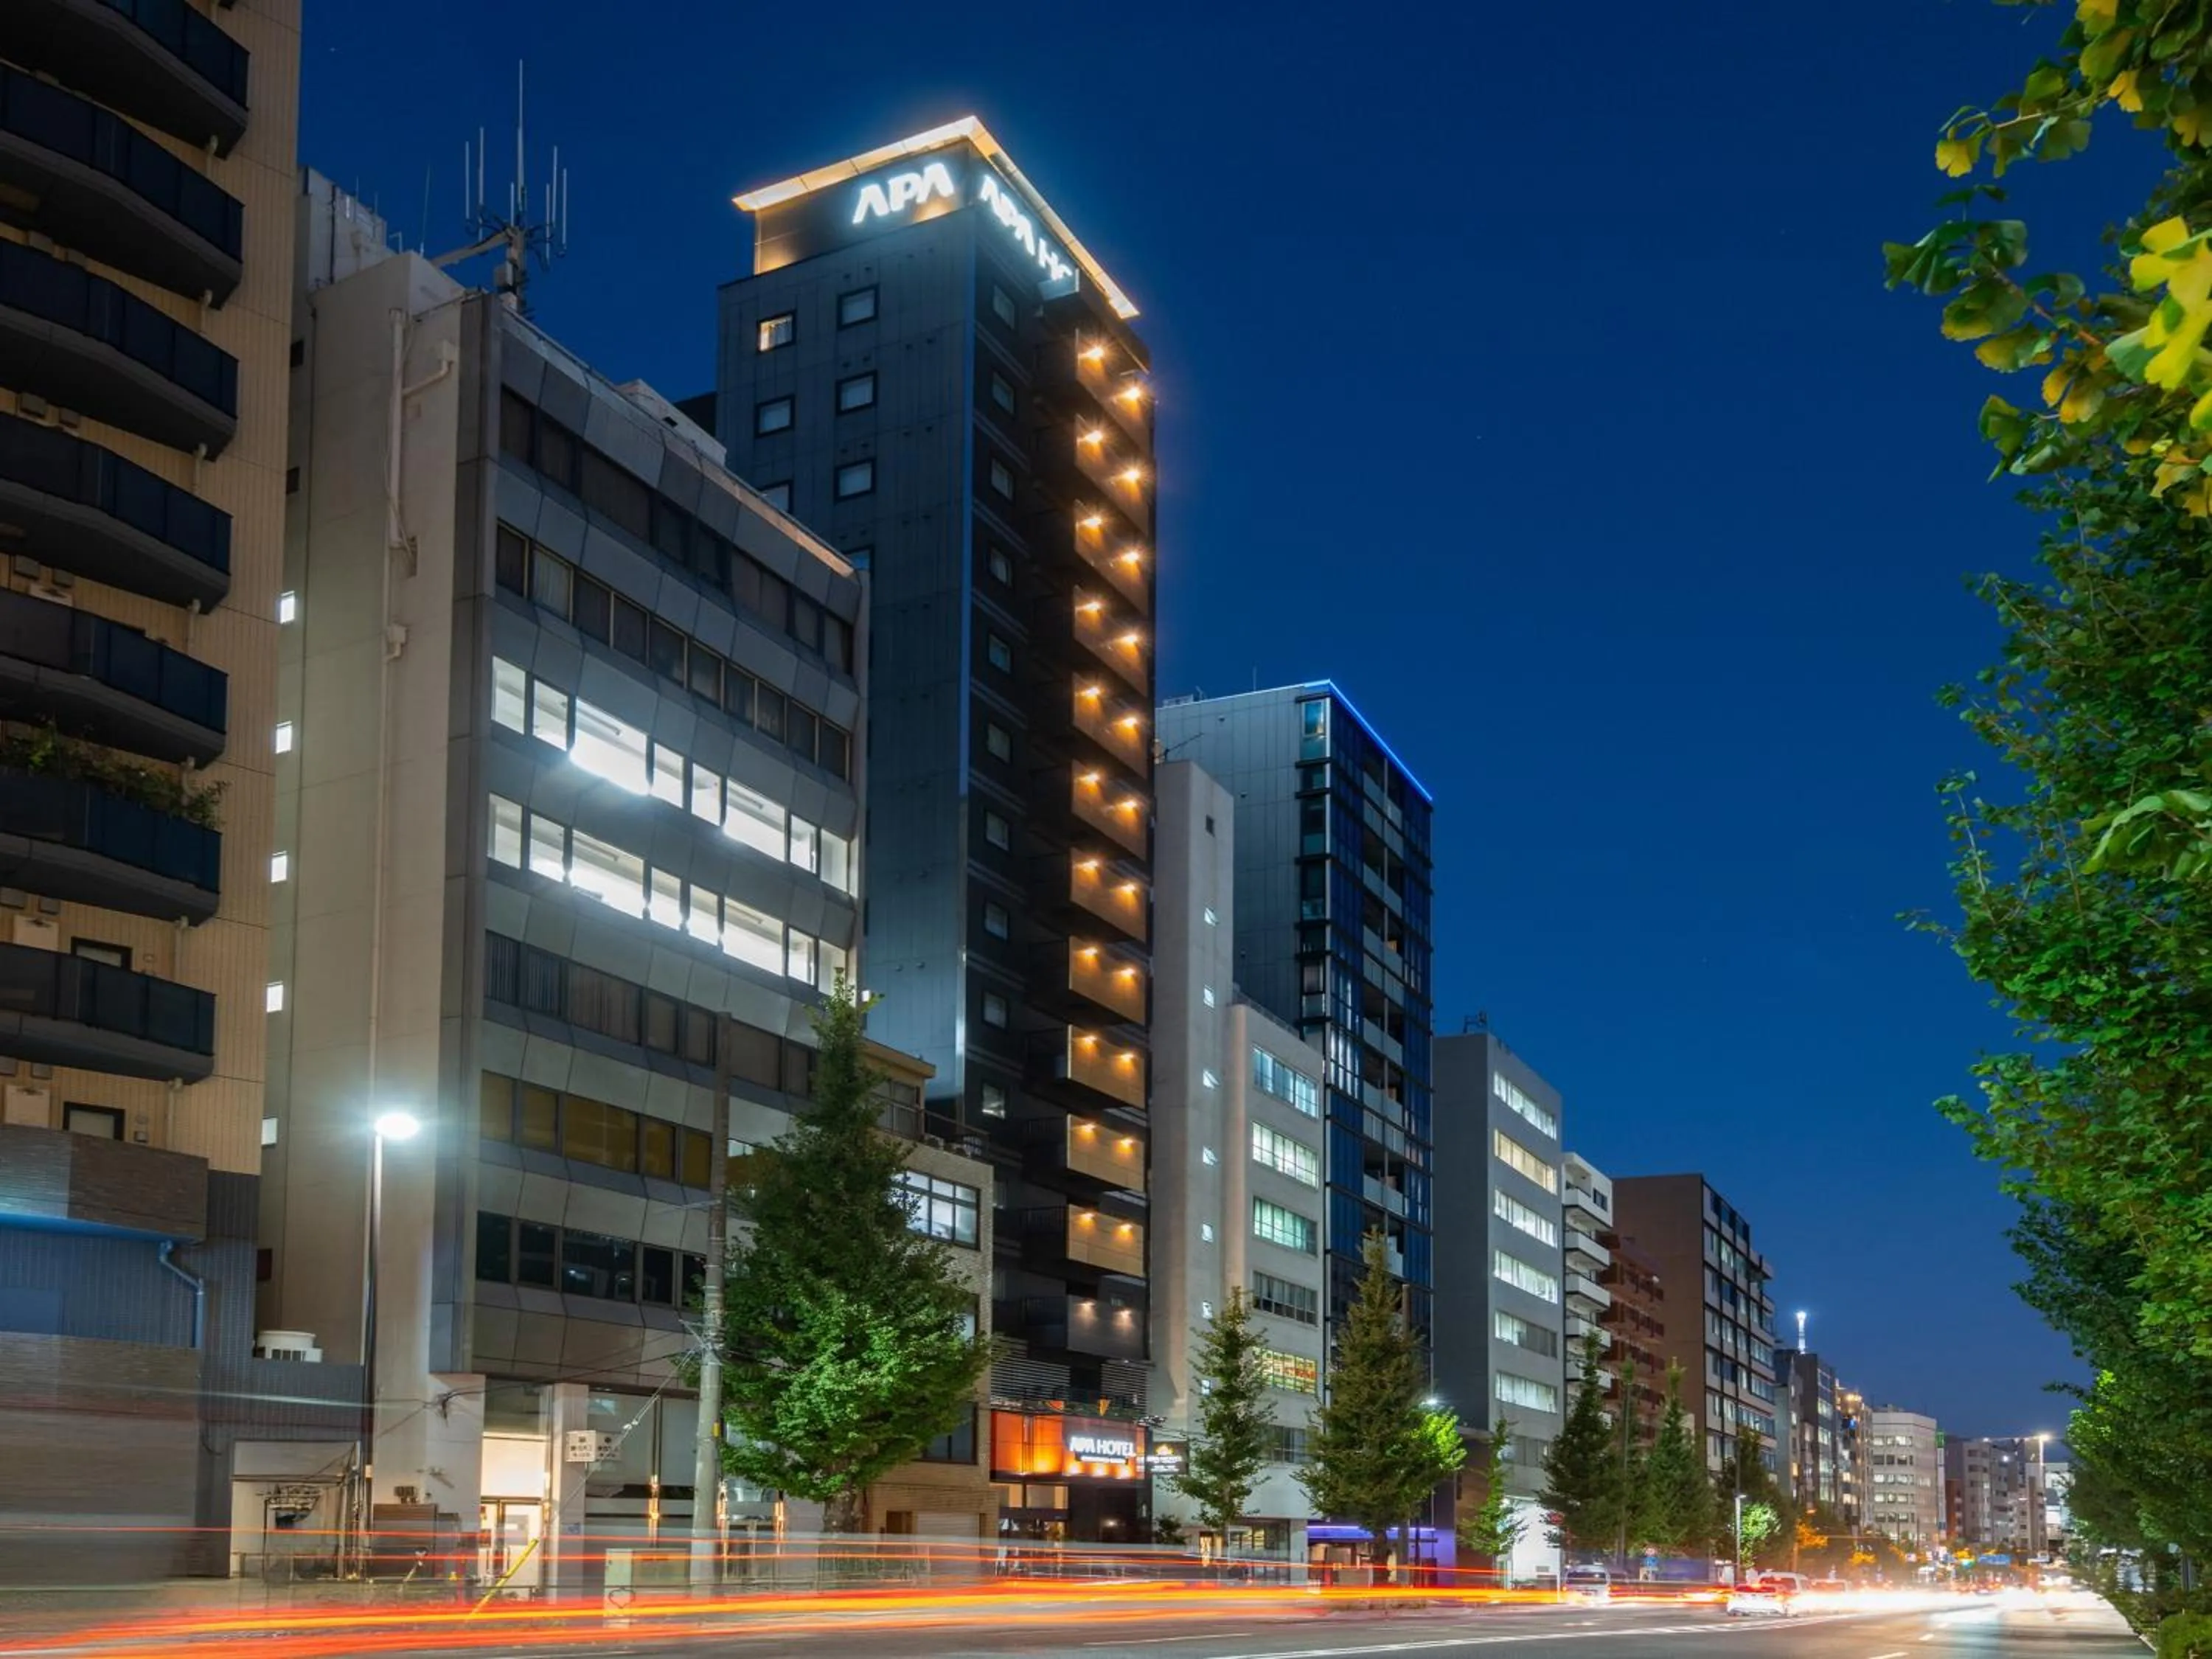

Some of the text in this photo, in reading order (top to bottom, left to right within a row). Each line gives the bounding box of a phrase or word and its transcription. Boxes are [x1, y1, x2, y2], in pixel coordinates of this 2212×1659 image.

[852, 161, 955, 224] APA
[979, 174, 1035, 256] APA
[1070, 1436, 1134, 1457] APA HOTEL
